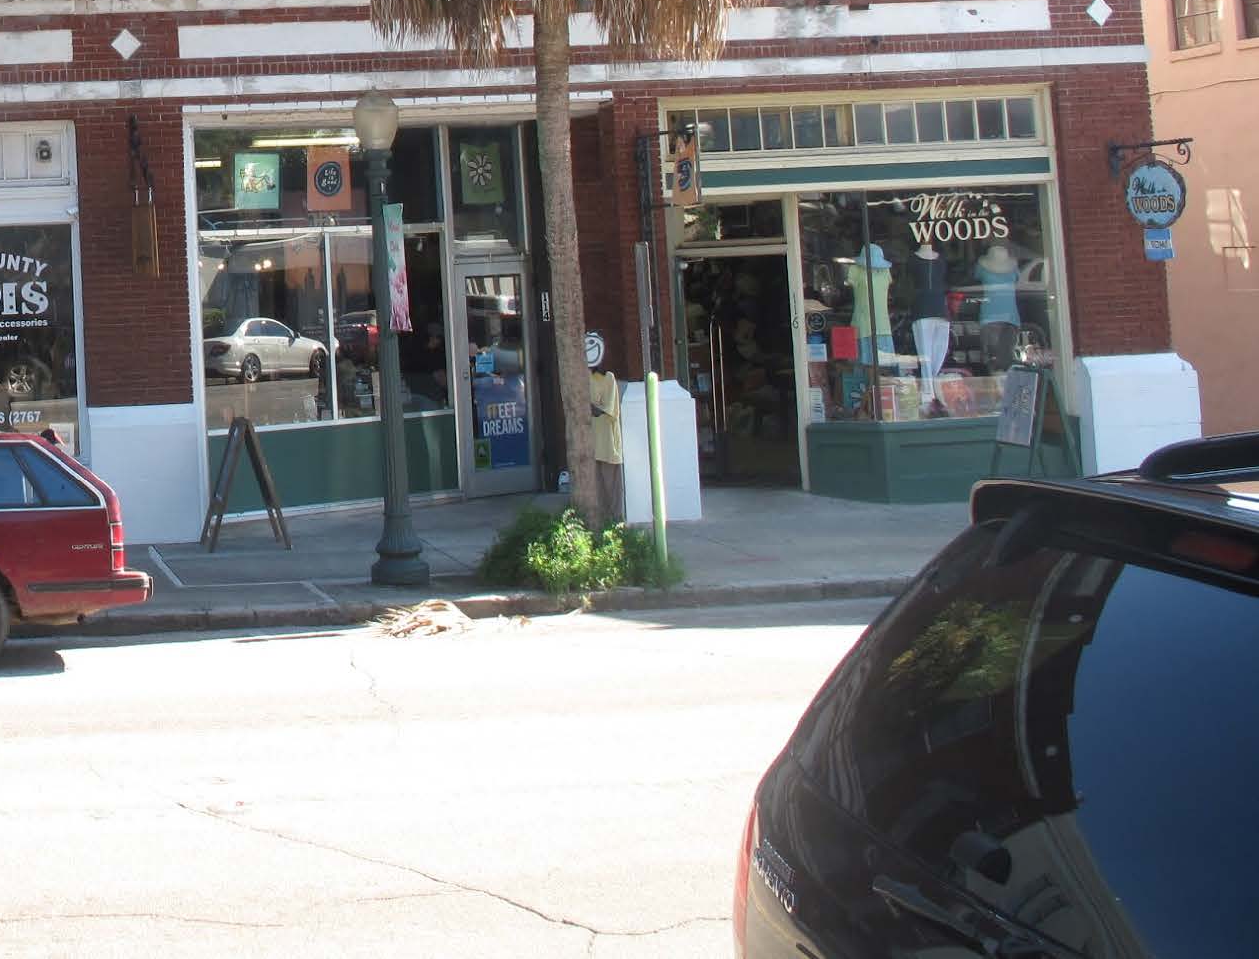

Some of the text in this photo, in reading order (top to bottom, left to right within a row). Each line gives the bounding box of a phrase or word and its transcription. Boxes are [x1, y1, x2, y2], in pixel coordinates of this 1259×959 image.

[910, 193, 966, 221] Walk
[1132, 194, 1176, 214] WOODS
[908, 216, 1009, 243] WOODS
[483, 418, 525, 437] DREAMS
